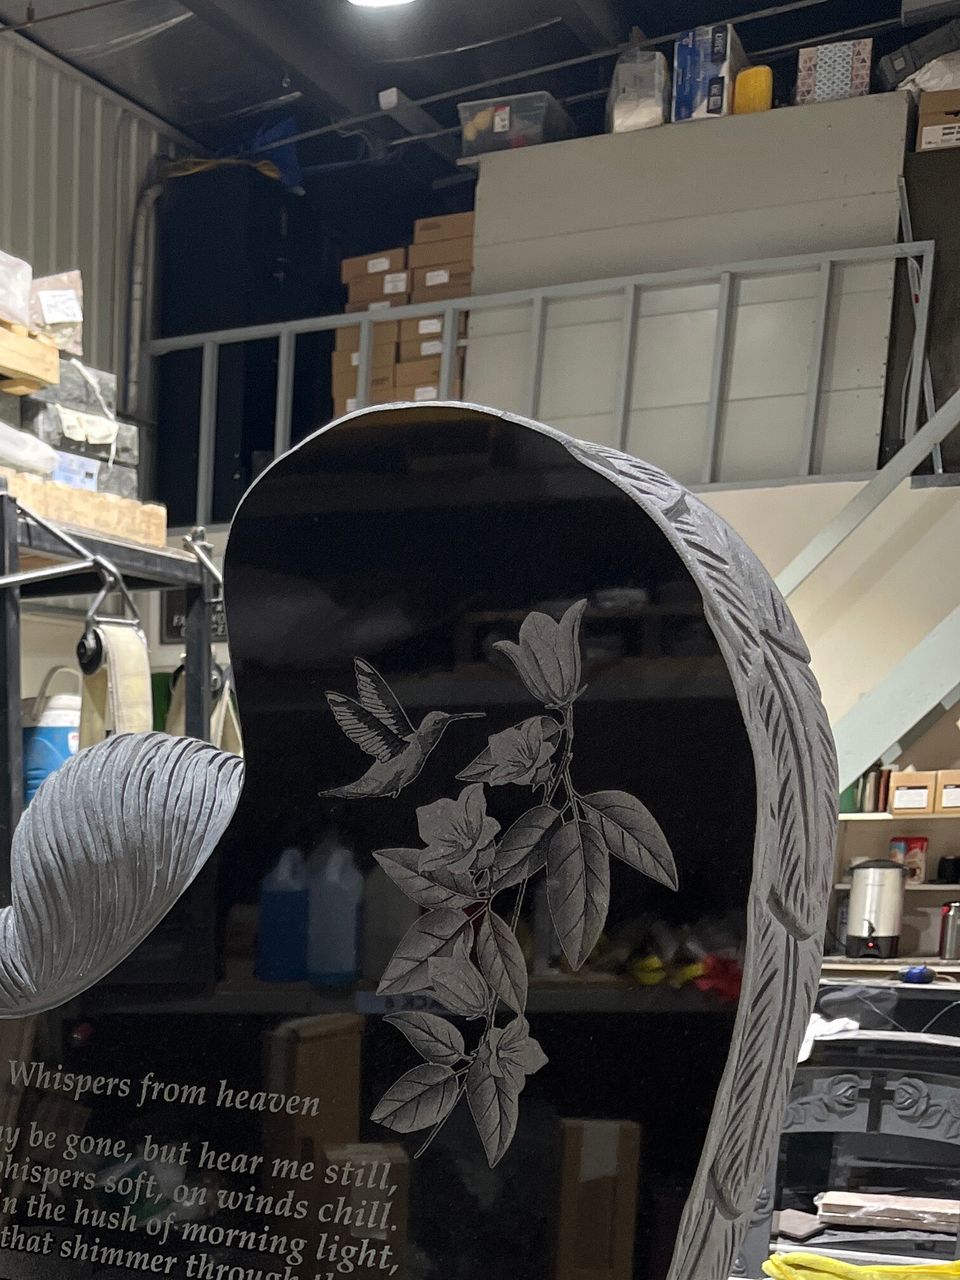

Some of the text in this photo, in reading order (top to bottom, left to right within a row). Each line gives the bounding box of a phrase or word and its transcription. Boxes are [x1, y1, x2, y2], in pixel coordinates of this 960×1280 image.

[10, 1060, 320, 1117] Whispers from heaven
[31, 1123, 57, 1149] be
[64, 1132, 133, 1164] gone,
[144, 1135, 190, 1166] but
[199, 1139, 260, 1174] hear
[272, 1156, 315, 1181] me
[324, 1158, 398, 1196] still,
[106, 1172, 163, 1204] soft,
[174, 1185, 208, 1206] on
[217, 1188, 307, 1220] winds
[319, 1199, 398, 1233] chill.
[0, 1221, 53, 1255] that
[60, 1234, 177, 1276] shimmer
[27, 1191, 65, 1221] the
[74, 1201, 137, 1233] hush
[146, 1210, 175, 1238] of
[183, 1218, 306, 1265] morning
[317, 1234, 399, 1277] light,
